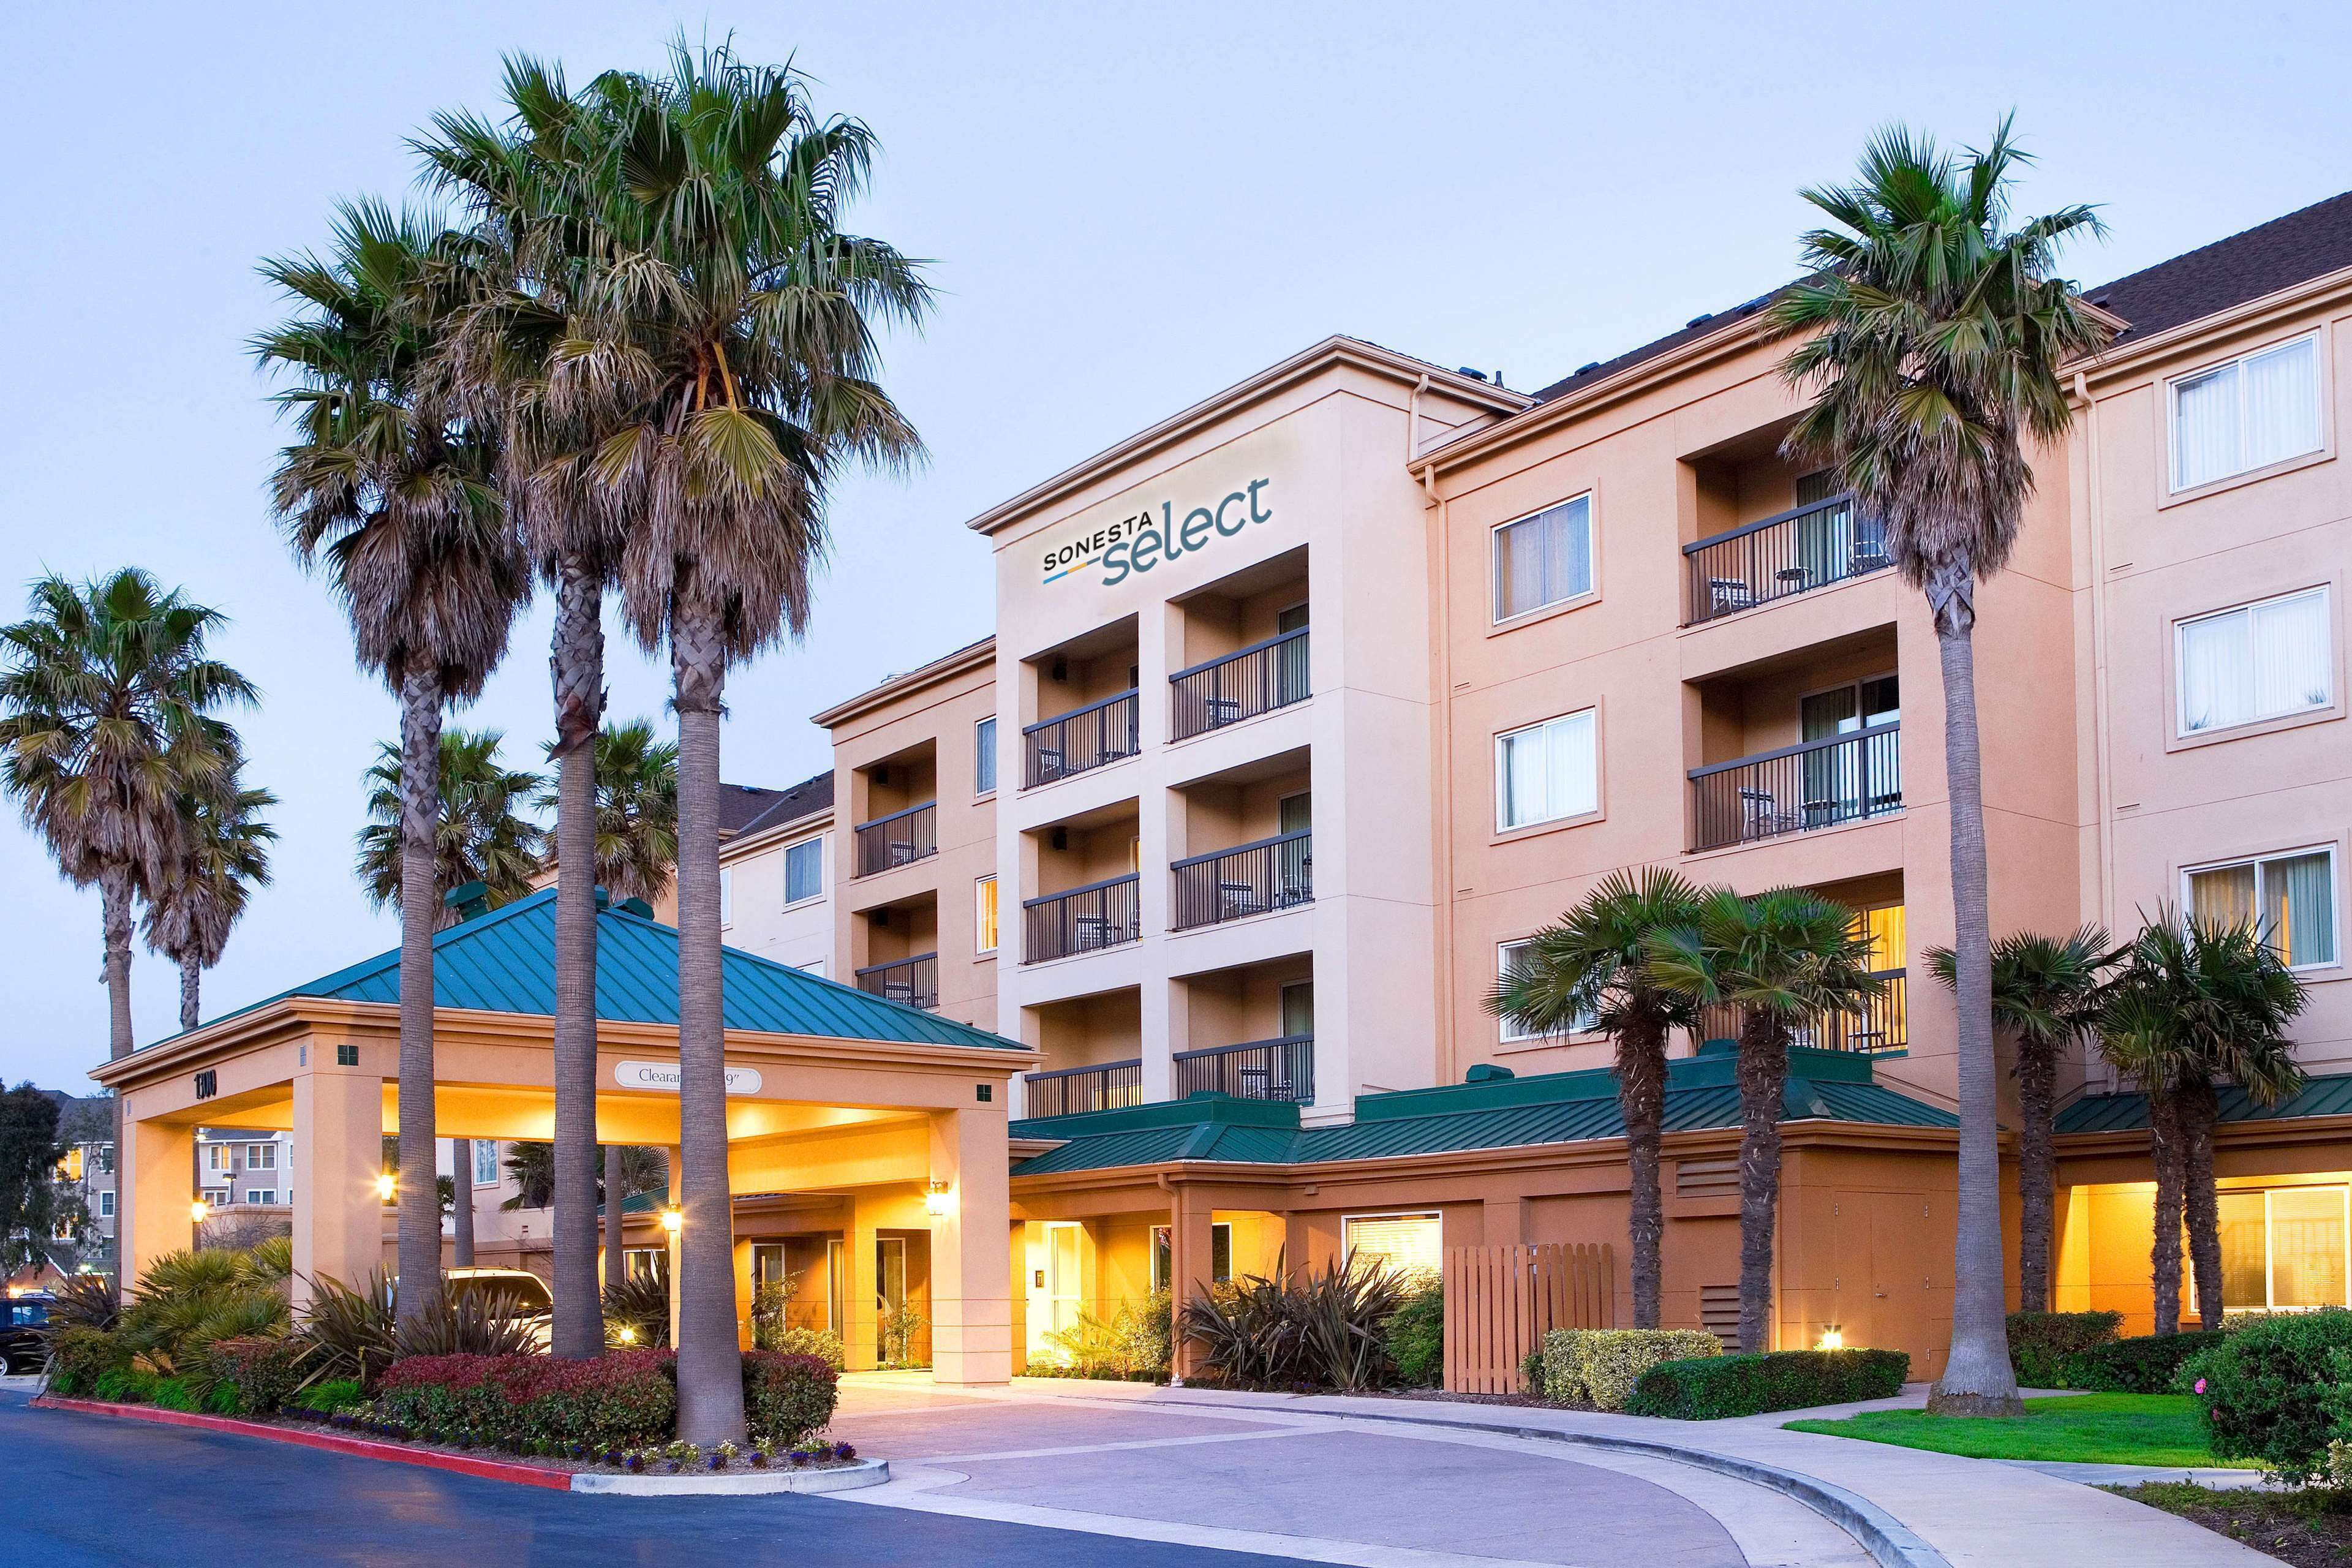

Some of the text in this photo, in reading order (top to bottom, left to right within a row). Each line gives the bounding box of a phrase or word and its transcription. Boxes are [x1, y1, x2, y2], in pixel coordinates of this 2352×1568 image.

[1043, 511, 1153, 571] SONESTA
[1102, 477, 1273, 586] select
[194, 1069, 217, 1099] 1300
[639, 1068, 680, 1083] Cleara
